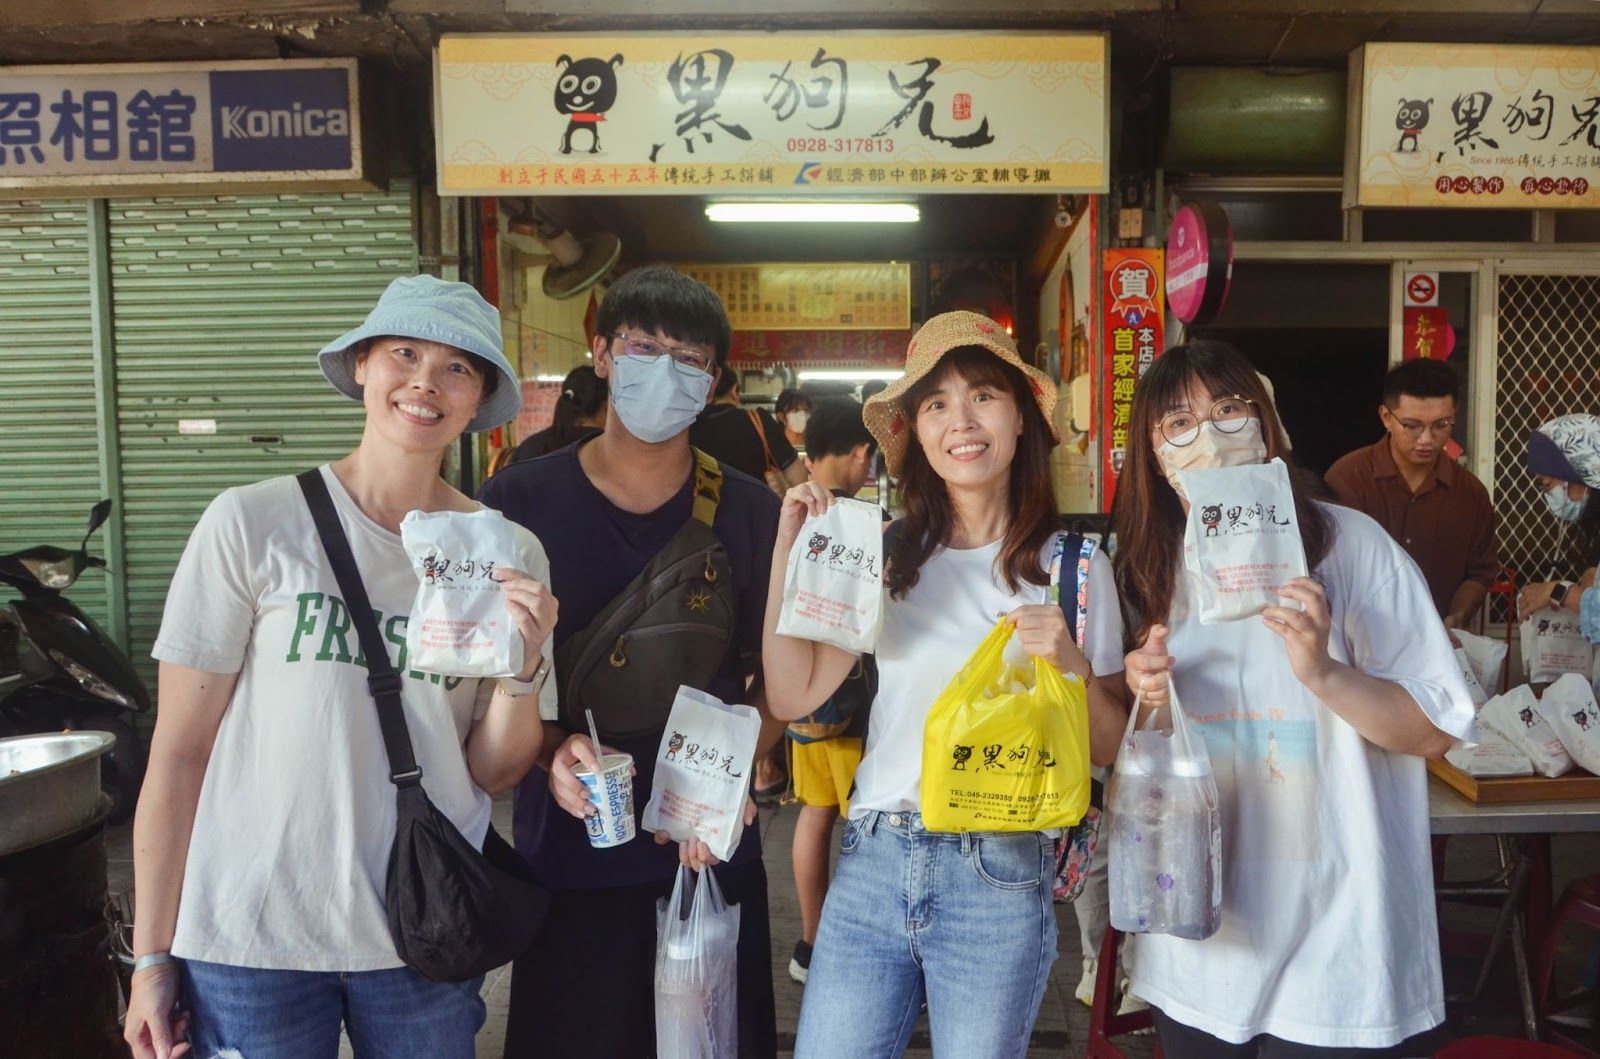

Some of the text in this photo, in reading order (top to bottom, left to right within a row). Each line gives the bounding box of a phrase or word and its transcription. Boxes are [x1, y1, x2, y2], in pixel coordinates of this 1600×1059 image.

[220, 102, 348, 140] Konica
[648, 47, 995, 162] 黑狗兄
[1436, 88, 1600, 163] 黑狗兄
[787, 138, 895, 153] 0928-317813
[1469, 155, 1492, 165] Since
[1495, 155, 1514, 165] 1966
[1118, 267, 1150, 300] 賀
[1225, 501, 1291, 535] 黑狗兄
[434, 557, 508, 584] 黑狗兄
[822, 544, 879, 578] 黑狗兄
[678, 743, 742, 778] 黑狗兄
[975, 743, 1057, 773] 黑狗兄
